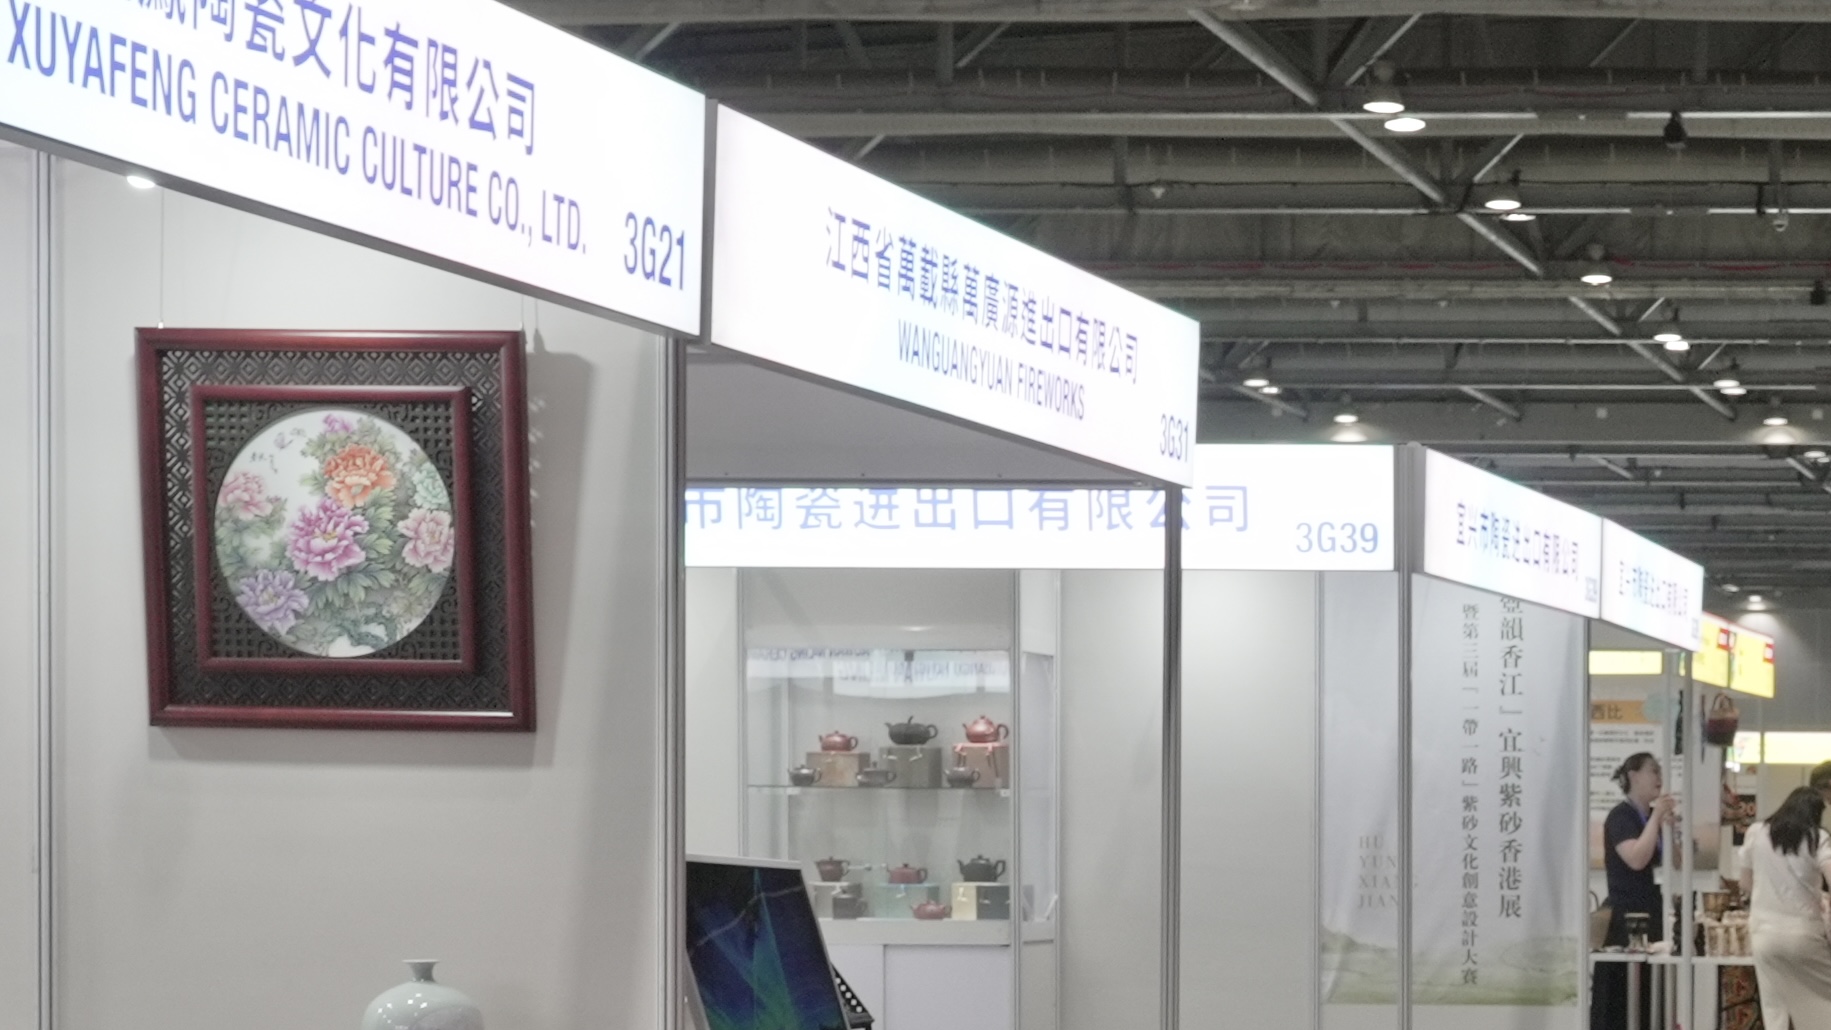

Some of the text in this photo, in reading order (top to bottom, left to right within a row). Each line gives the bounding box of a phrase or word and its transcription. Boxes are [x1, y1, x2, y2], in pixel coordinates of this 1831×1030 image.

[7, 0, 685, 291] XUYAFENG CERAMIC CULTURE CO., LTD. 3G21
[137, 0, 535, 155] 瓷文化有限公司
[899, 319, 1190, 464] WANGUANGYUAN FIREWORKS 3G31
[1295, 521, 1380, 555] 3G39
